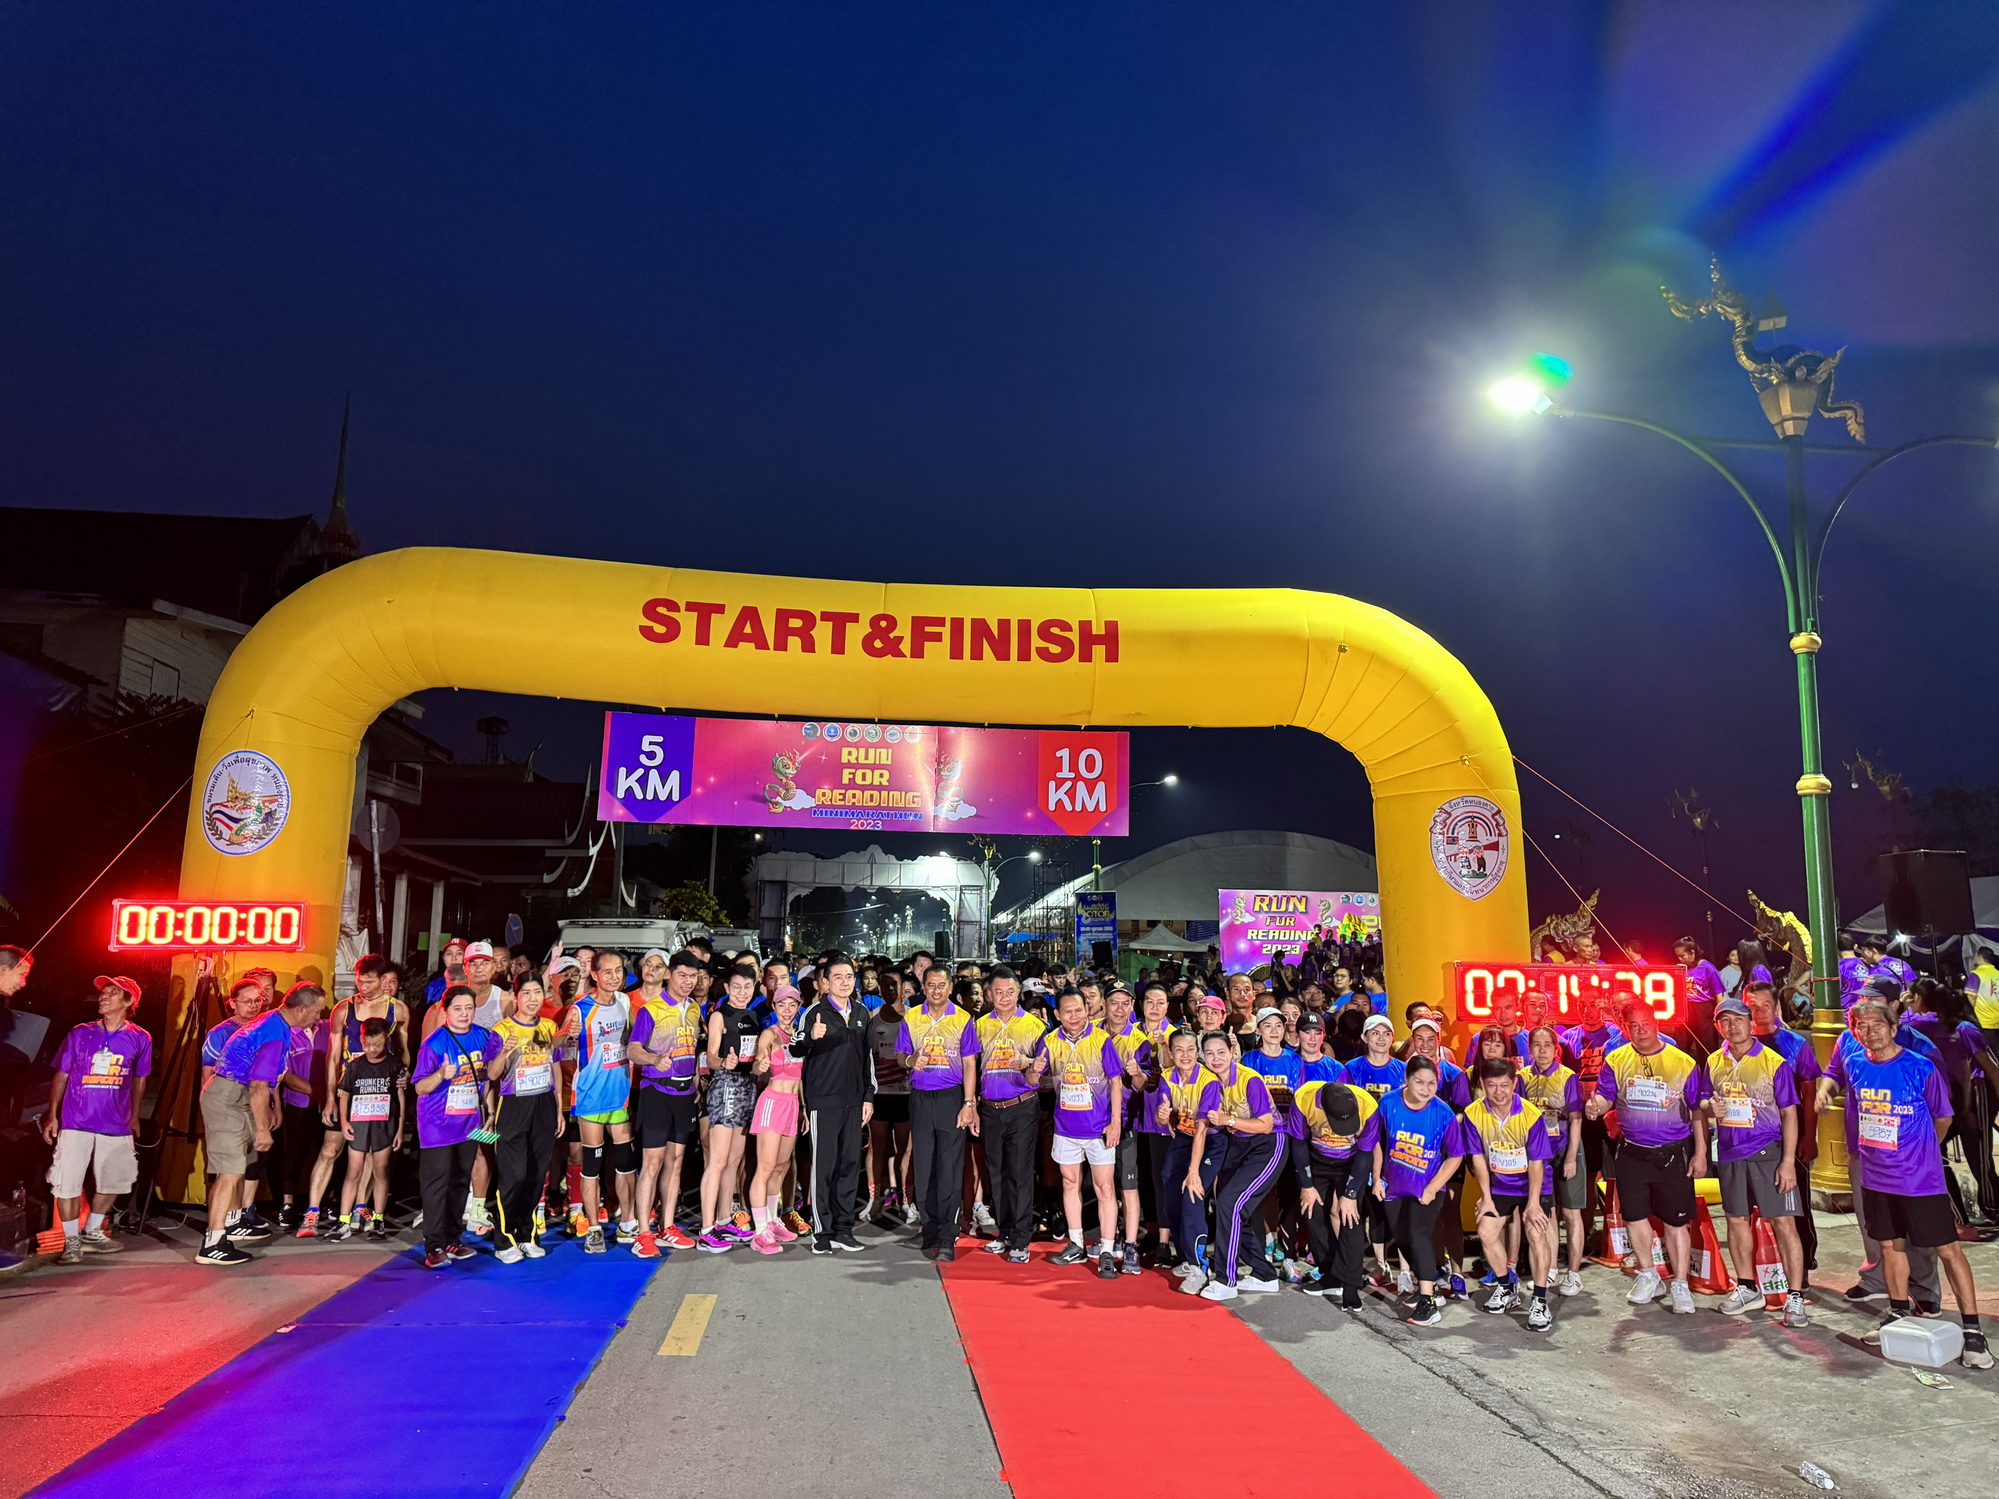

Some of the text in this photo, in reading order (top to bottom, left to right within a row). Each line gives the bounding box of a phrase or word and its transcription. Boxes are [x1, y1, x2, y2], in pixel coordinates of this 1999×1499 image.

[638, 597, 1120, 664] START&FINISH
[639, 735, 664, 767] 5
[841, 747, 892, 764] RUN
[1055, 748, 1103, 779] 10
[617, 767, 680, 802] KM
[842, 768, 890, 786] FOR
[815, 788, 922, 808] READING
[1048, 780, 1107, 812] KM
[850, 819, 882, 830] 2023
[1253, 895, 1308, 913] RUN
[118, 905, 300, 945] 00:00:00
[1265, 915, 1296, 927] FOR
[1365, 1083, 1392, 1092] RUN
[1860, 1088, 1891, 1102] RUN
[1860, 1101, 1914, 1115] FOR 2023
[1396, 1130, 1425, 1147] RUN
[1395, 1141, 1424, 1159] FOR
